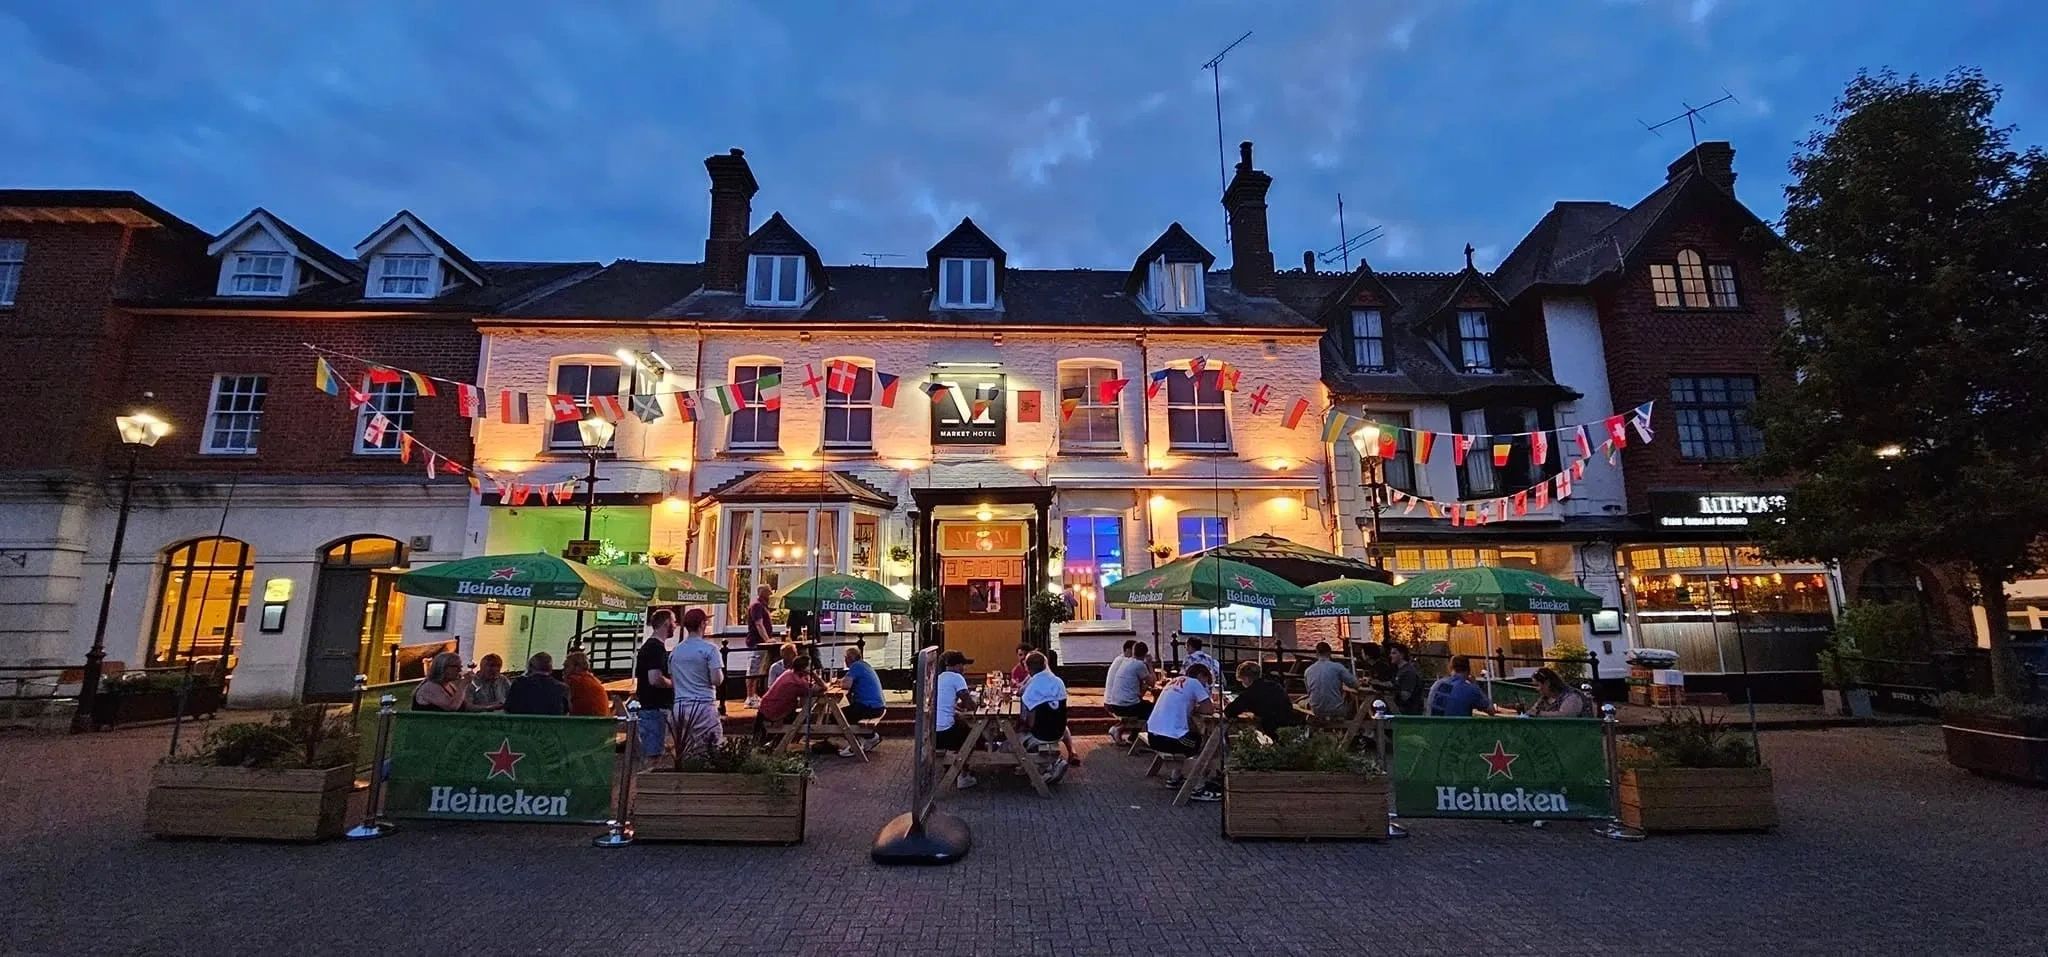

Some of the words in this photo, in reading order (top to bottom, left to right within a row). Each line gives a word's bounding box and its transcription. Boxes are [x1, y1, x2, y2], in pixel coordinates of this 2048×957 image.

[457, 580, 533, 598] Heineken
[677, 590, 708, 601] Heineken
[1127, 590, 1164, 603] Heineken
[1226, 588, 1277, 607] Heineken
[1410, 596, 1462, 609] Heineken
[821, 599, 874, 612] Heineken
[1528, 598, 1571, 612] Heineken
[428, 785, 568, 816] Heineken
[1435, 785, 1569, 812] Heineken
